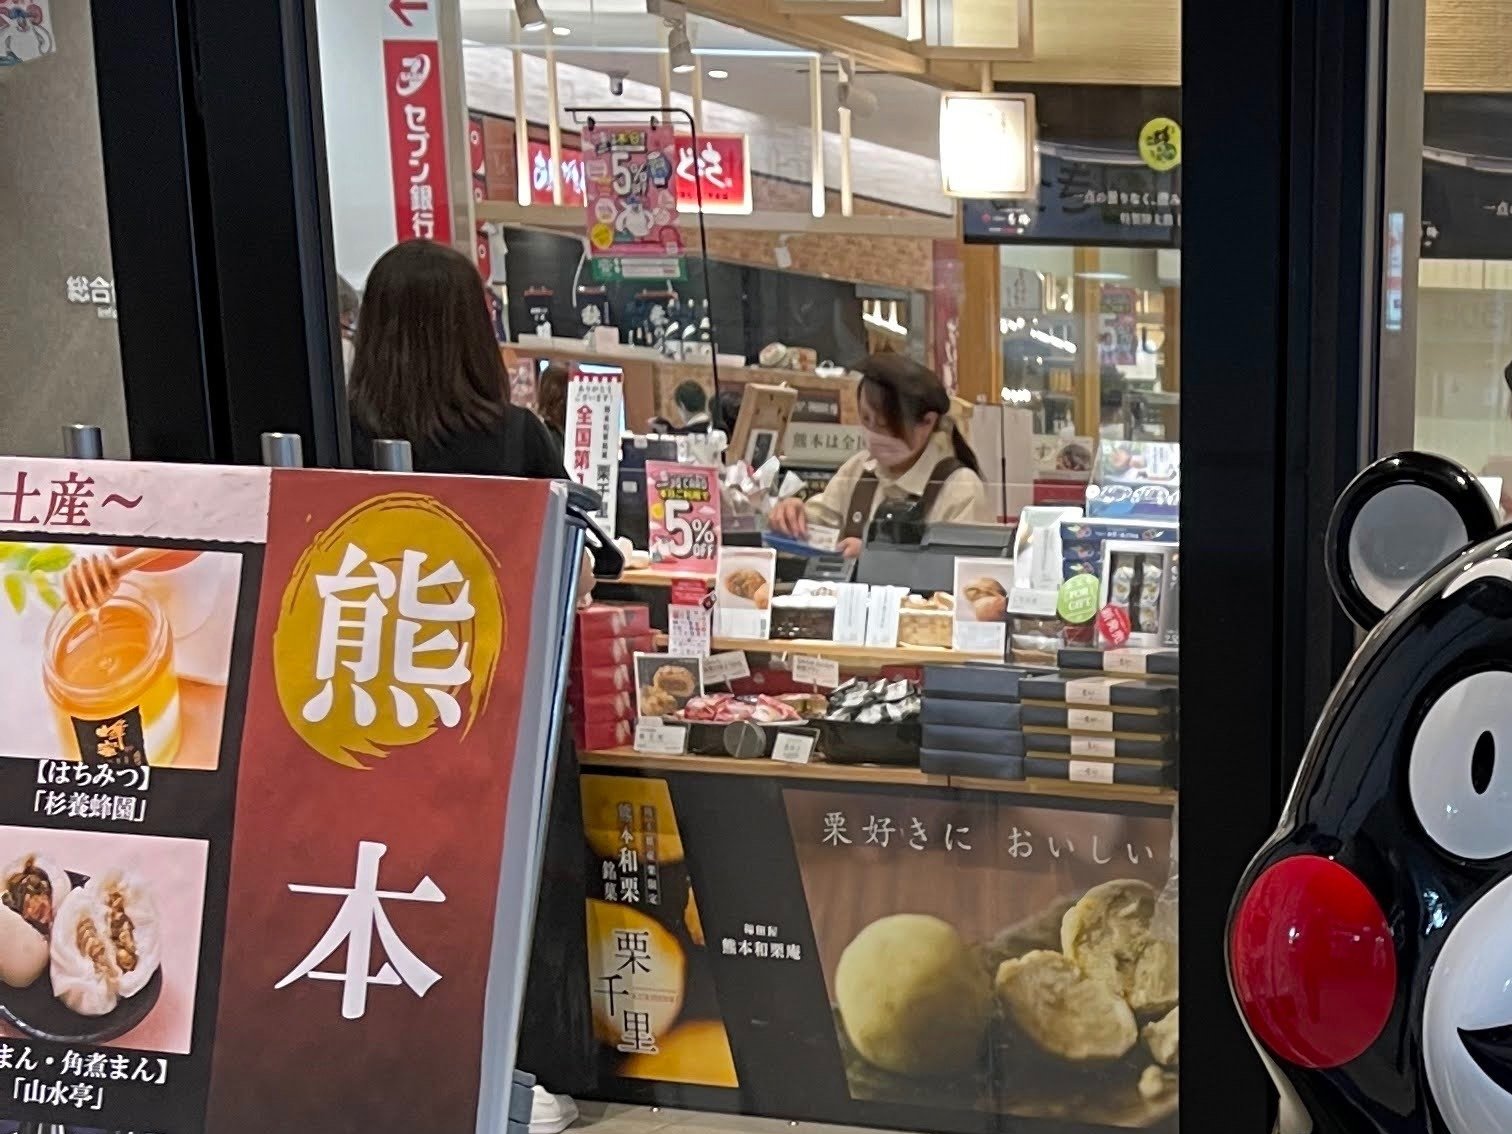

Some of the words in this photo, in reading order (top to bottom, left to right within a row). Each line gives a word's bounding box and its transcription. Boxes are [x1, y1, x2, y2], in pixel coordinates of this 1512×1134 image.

[403, 103, 436, 240] セブン銀行
[65, 274, 115, 307] 総合
[37, 759, 151, 791] 【はちみつ】
[33, 789, 147, 822] 「杉養蜂園」
[822, 810, 973, 852] 栗好きに
[1006, 826, 1155, 866] おいしい
[593, 929, 660, 1055] 栗千里
[0, 1043, 168, 1085] まん・角煮まん】
[13, 1076, 104, 1111] 「山水亭」
